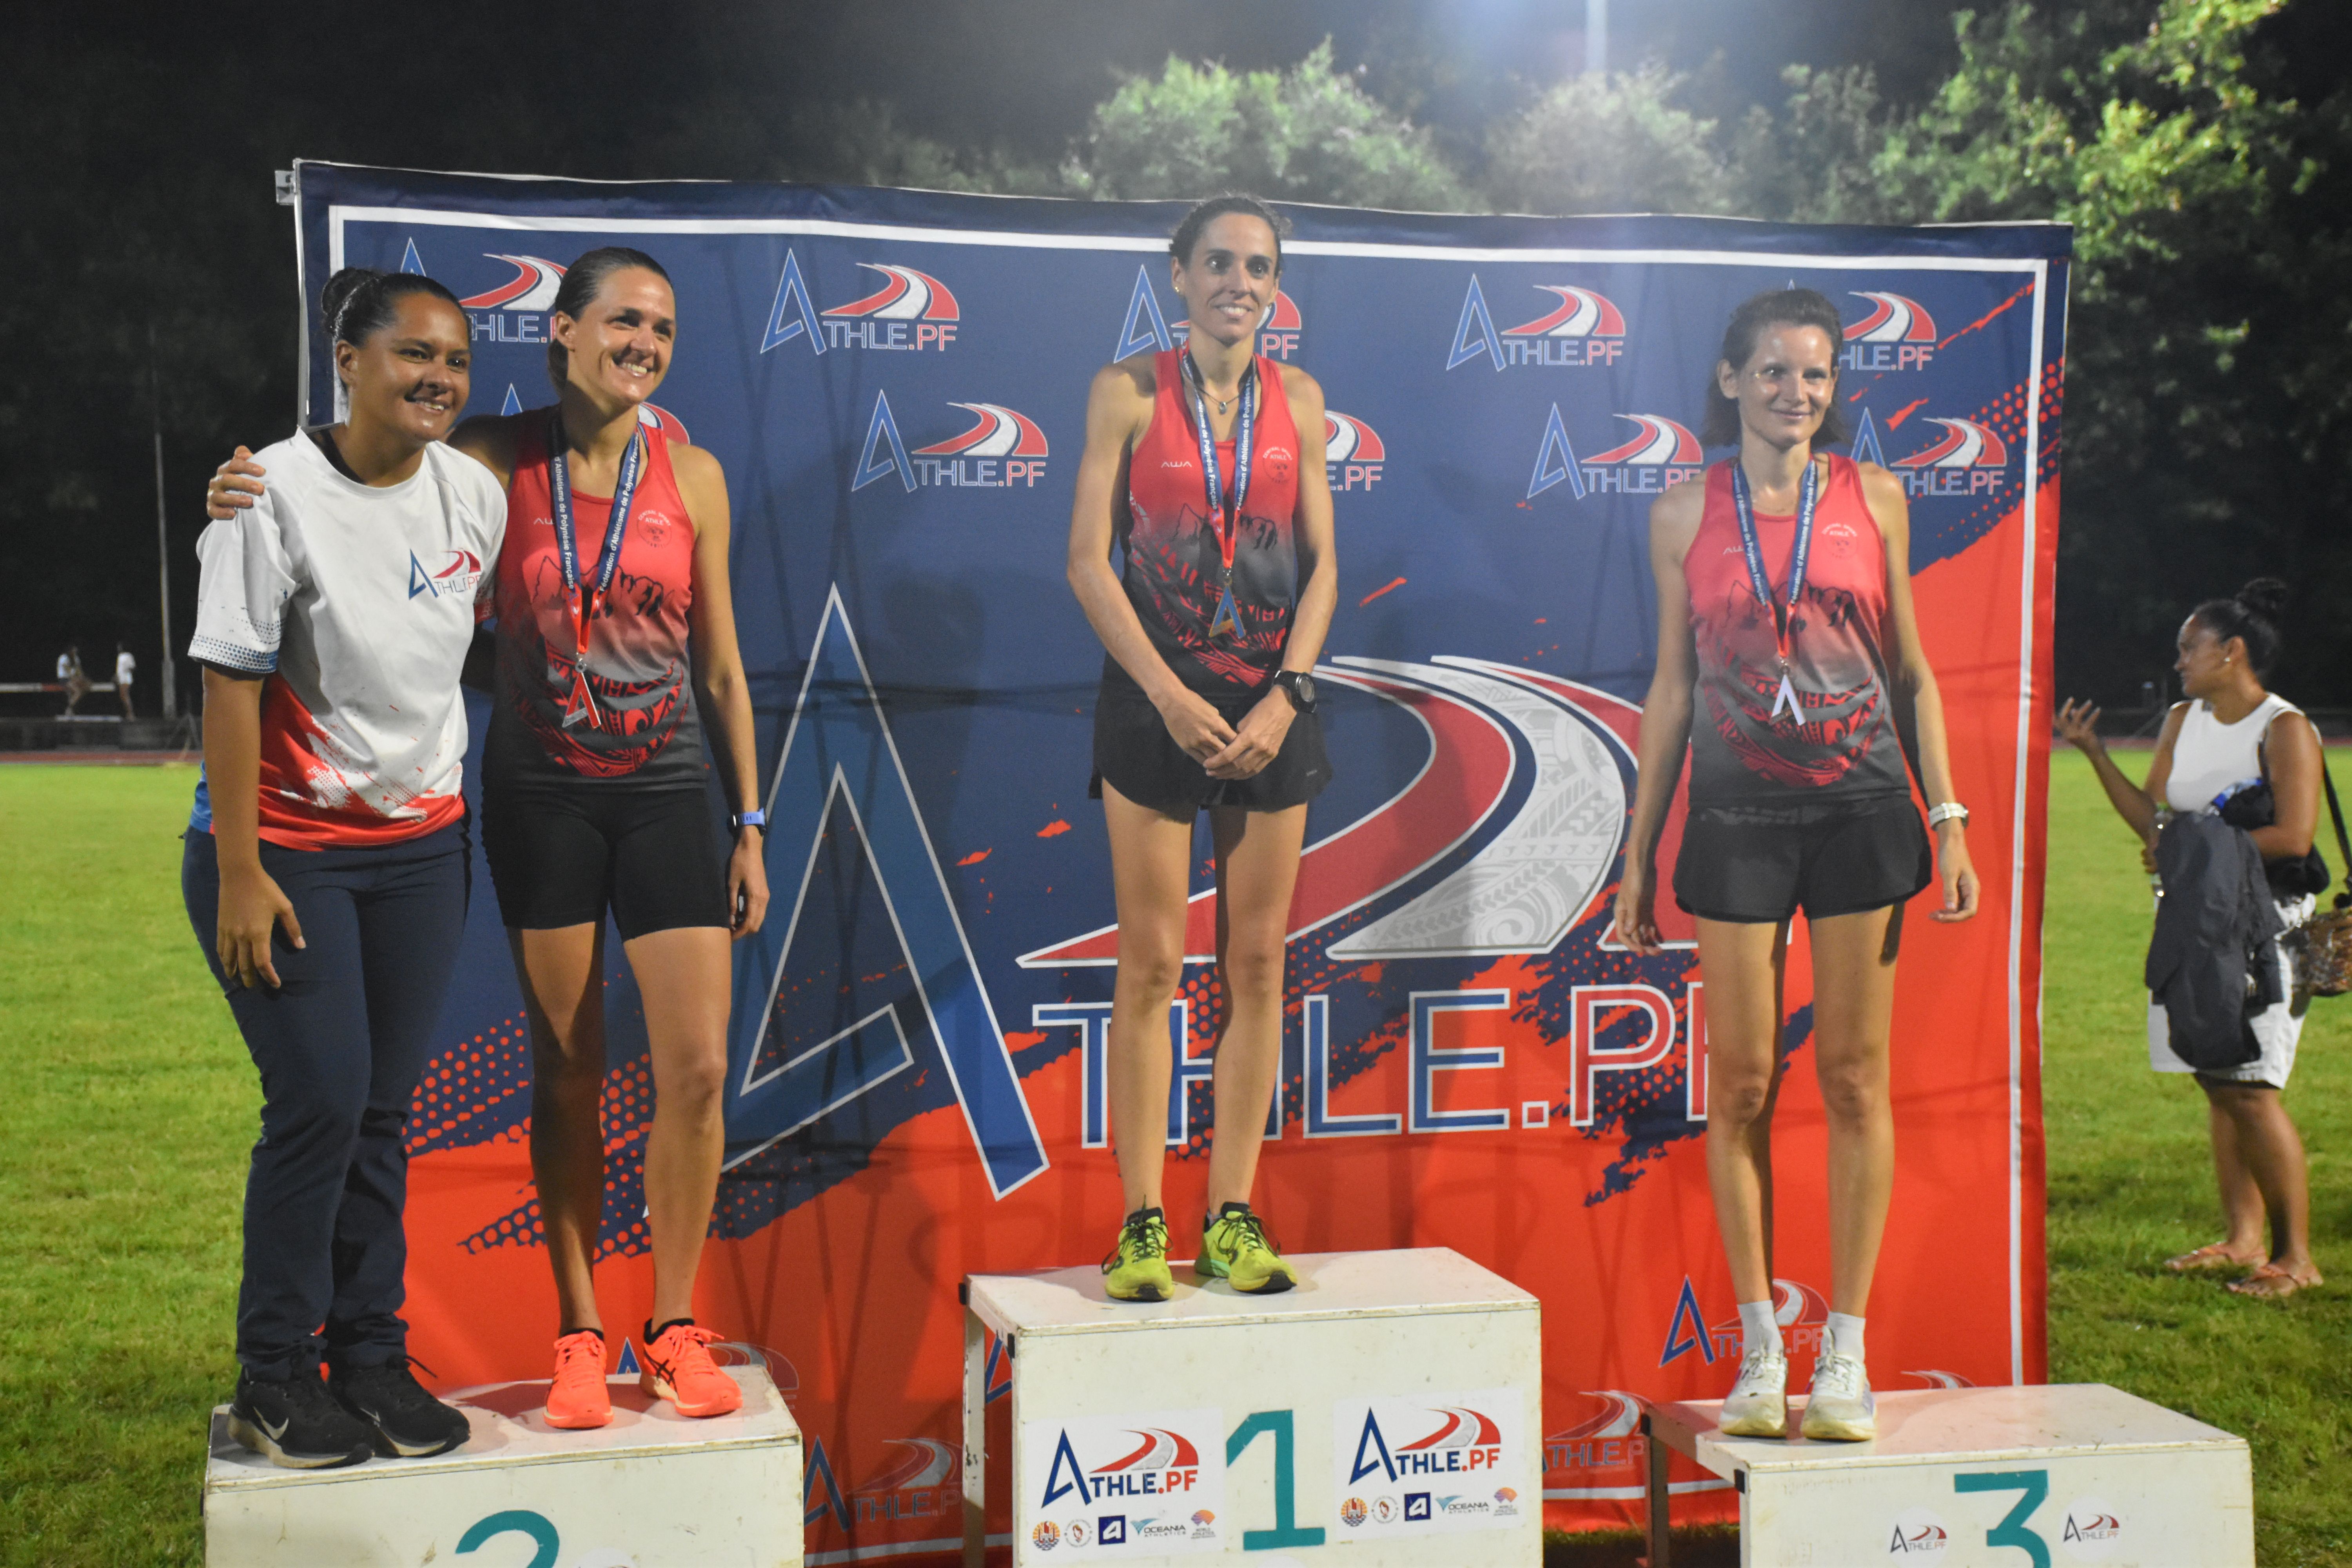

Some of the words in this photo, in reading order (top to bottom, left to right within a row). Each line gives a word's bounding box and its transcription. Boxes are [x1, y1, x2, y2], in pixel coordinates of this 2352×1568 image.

[760, 247, 957, 355] ATHLE.PF
[1446, 273, 1624, 372] ATHLE.PF
[851, 389, 1046, 493] ATHLE.PF
[1202, 429, 1208, 438] de
[559, 503, 566, 513] de
[621, 497, 628, 506] de
[559, 514, 570, 550] Polynésie
[564, 552, 574, 589] Française
[720, 581, 1709, 1201] ATHLE.P
[1041, 1427, 1198, 1508] ATHLE.PF
[1348, 1406, 1501, 1486] ATHLE.PF
[803, 1435, 961, 1532] ATHLE.P
[1226, 1410, 1326, 1551] 1
[1448, 1502, 1489, 1510] OCEANIA
[1144, 1524, 1186, 1534] OCEANIA
[1890, 1524, 1946, 1553] ATHLE.PF
[1954, 1470, 2052, 1568] 3
[2063, 1513, 2119, 1543] ATHLE.PF
